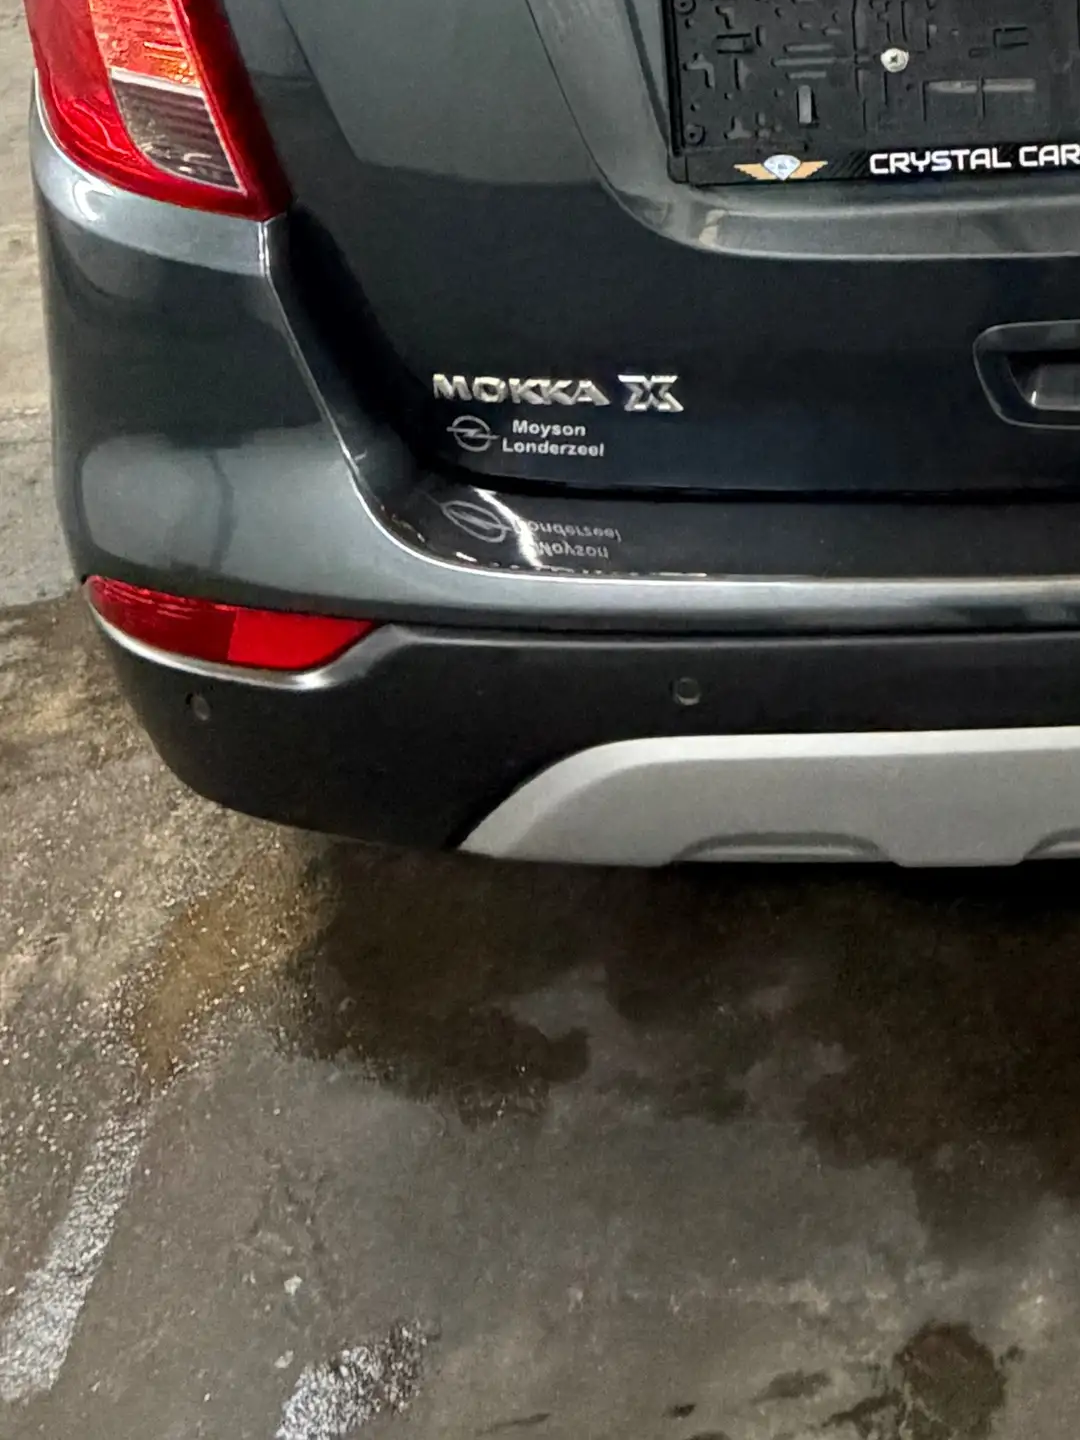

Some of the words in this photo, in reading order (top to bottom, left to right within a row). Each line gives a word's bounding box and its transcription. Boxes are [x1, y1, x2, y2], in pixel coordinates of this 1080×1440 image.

[869, 147, 1012, 175] CRYSTAL
[432, 373, 612, 406] MOKKA
[617, 374, 685, 412] X
[512, 419, 587, 439] Moyson
[501, 437, 606, 457] Londerzeel
